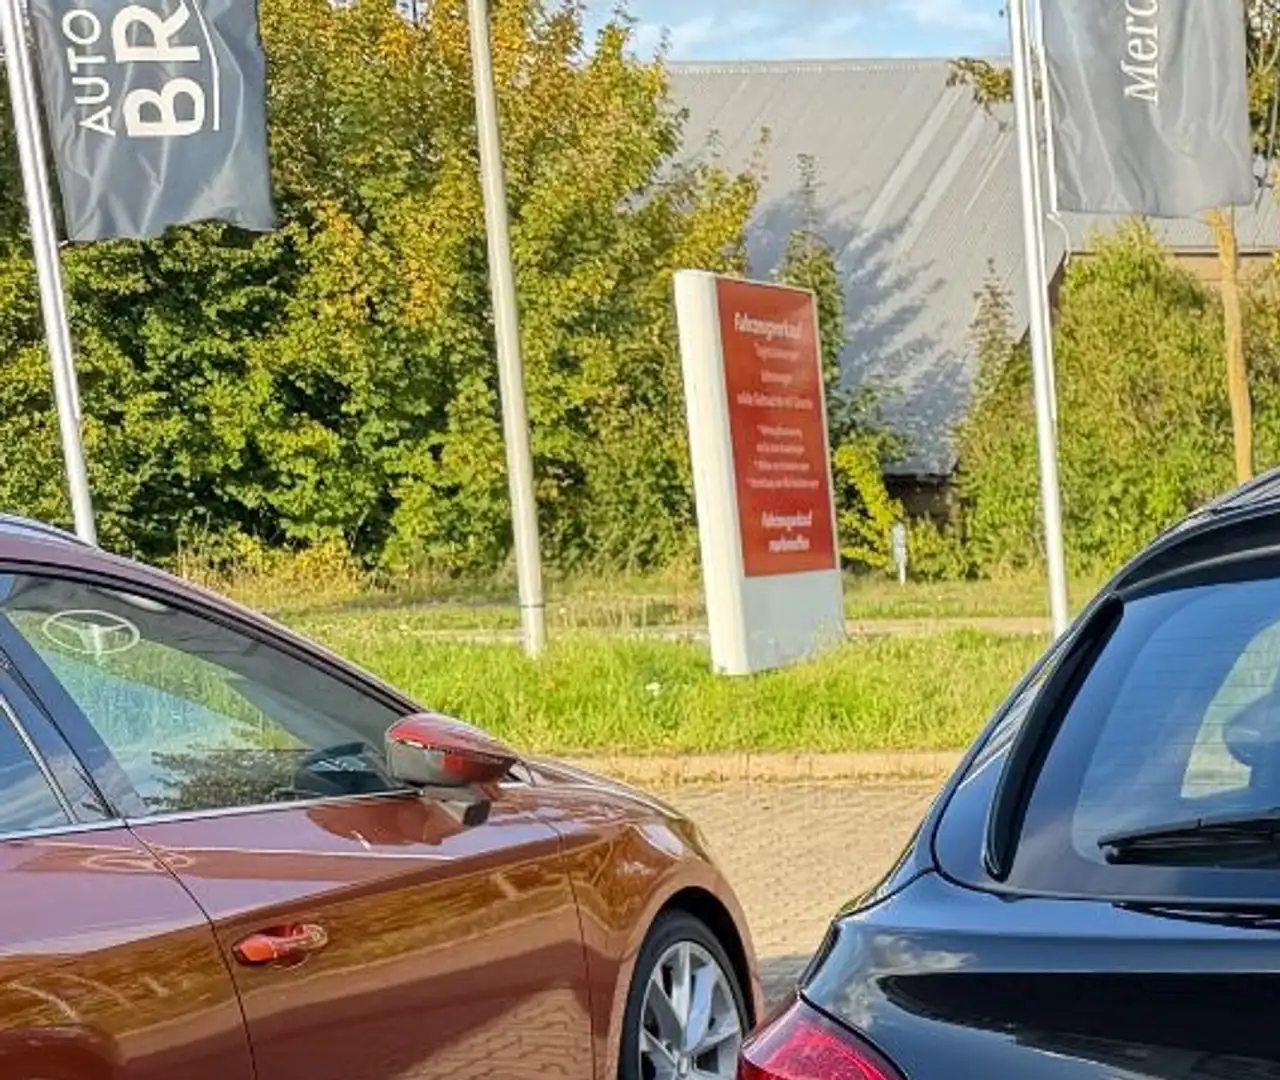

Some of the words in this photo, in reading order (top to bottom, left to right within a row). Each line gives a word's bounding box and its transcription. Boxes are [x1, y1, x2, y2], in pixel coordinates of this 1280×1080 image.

[61, 9, 116, 137] AUTO
[110, 0, 206, 137] BR
[1121, 0, 1159, 105] Merc
